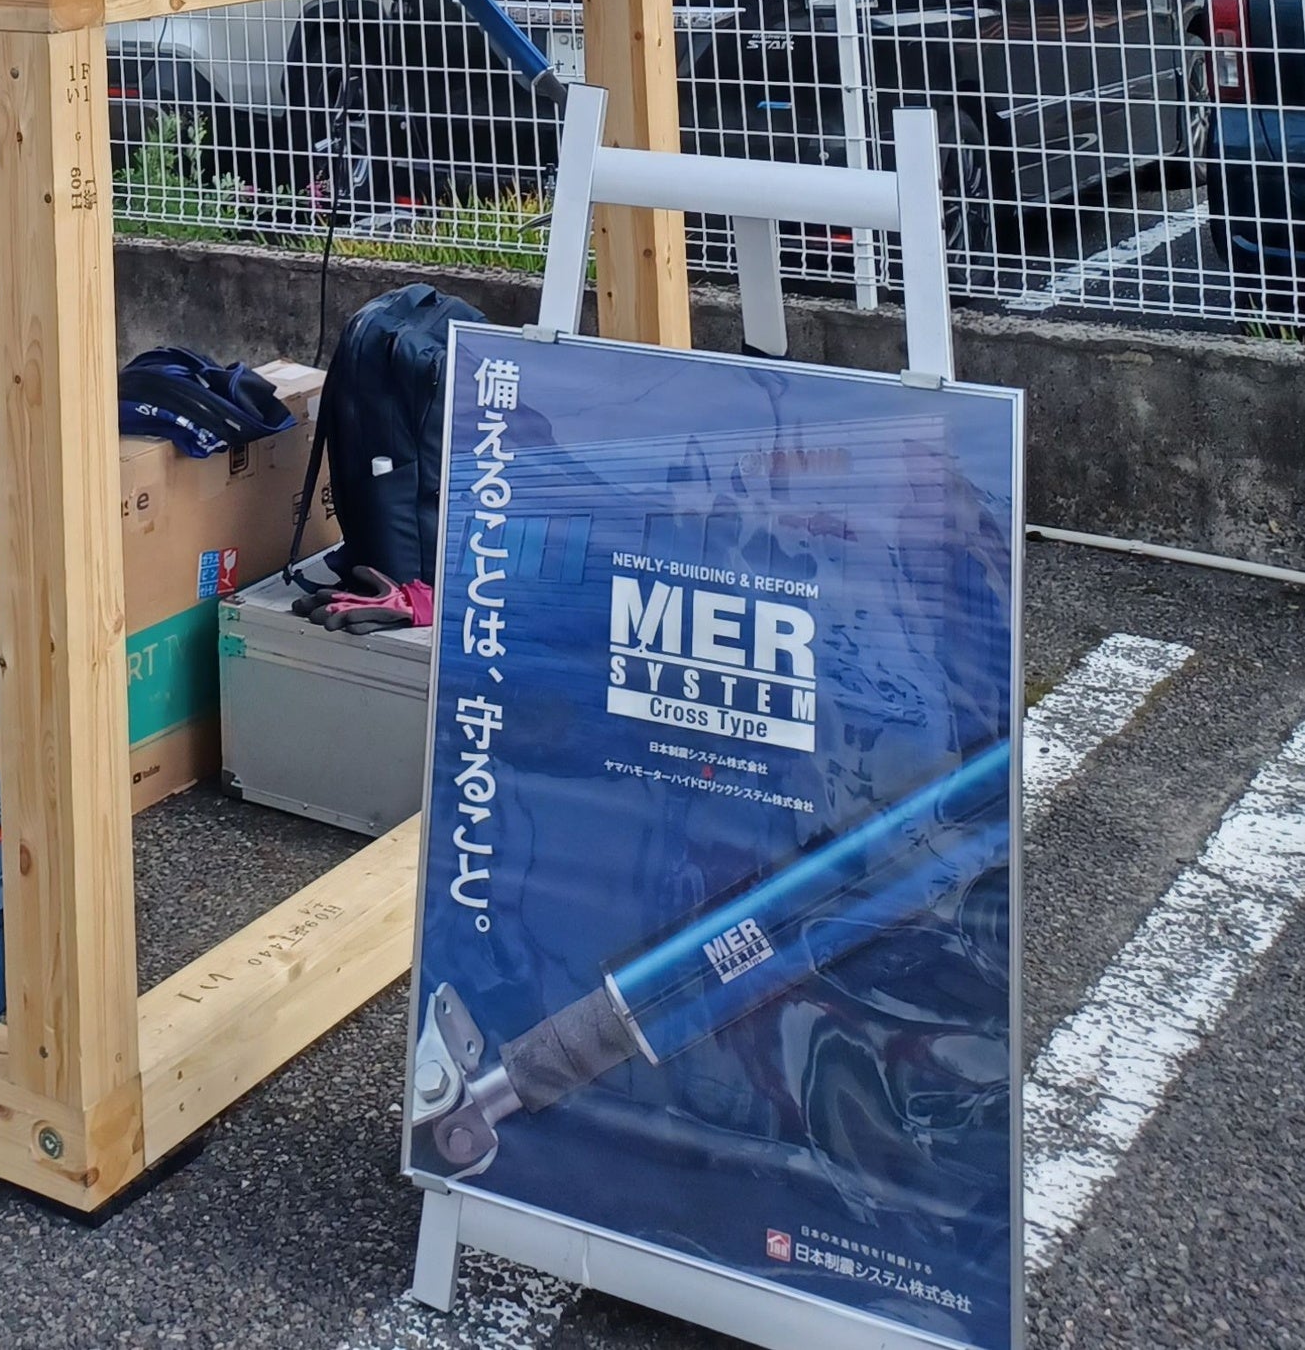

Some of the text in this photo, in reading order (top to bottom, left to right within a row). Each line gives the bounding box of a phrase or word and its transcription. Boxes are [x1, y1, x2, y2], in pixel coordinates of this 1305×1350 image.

[739, 573, 751, 587] &
[754, 575, 819, 599] REFORM
[449, 357, 521, 934] 備えることは、守ること。
[610, 575, 816, 679] MER
[609, 655, 816, 721] SYSTEM
[649, 697, 768, 737] Cross Type
[649, 741, 768, 775] 日本制震システム株式会社
[604, 759, 814, 813] ヤマハモーターハイドロリックシステム株式会社
[702, 917, 762, 965] MER
[795, 1243, 973, 1314] 日本制震システム株式会社
